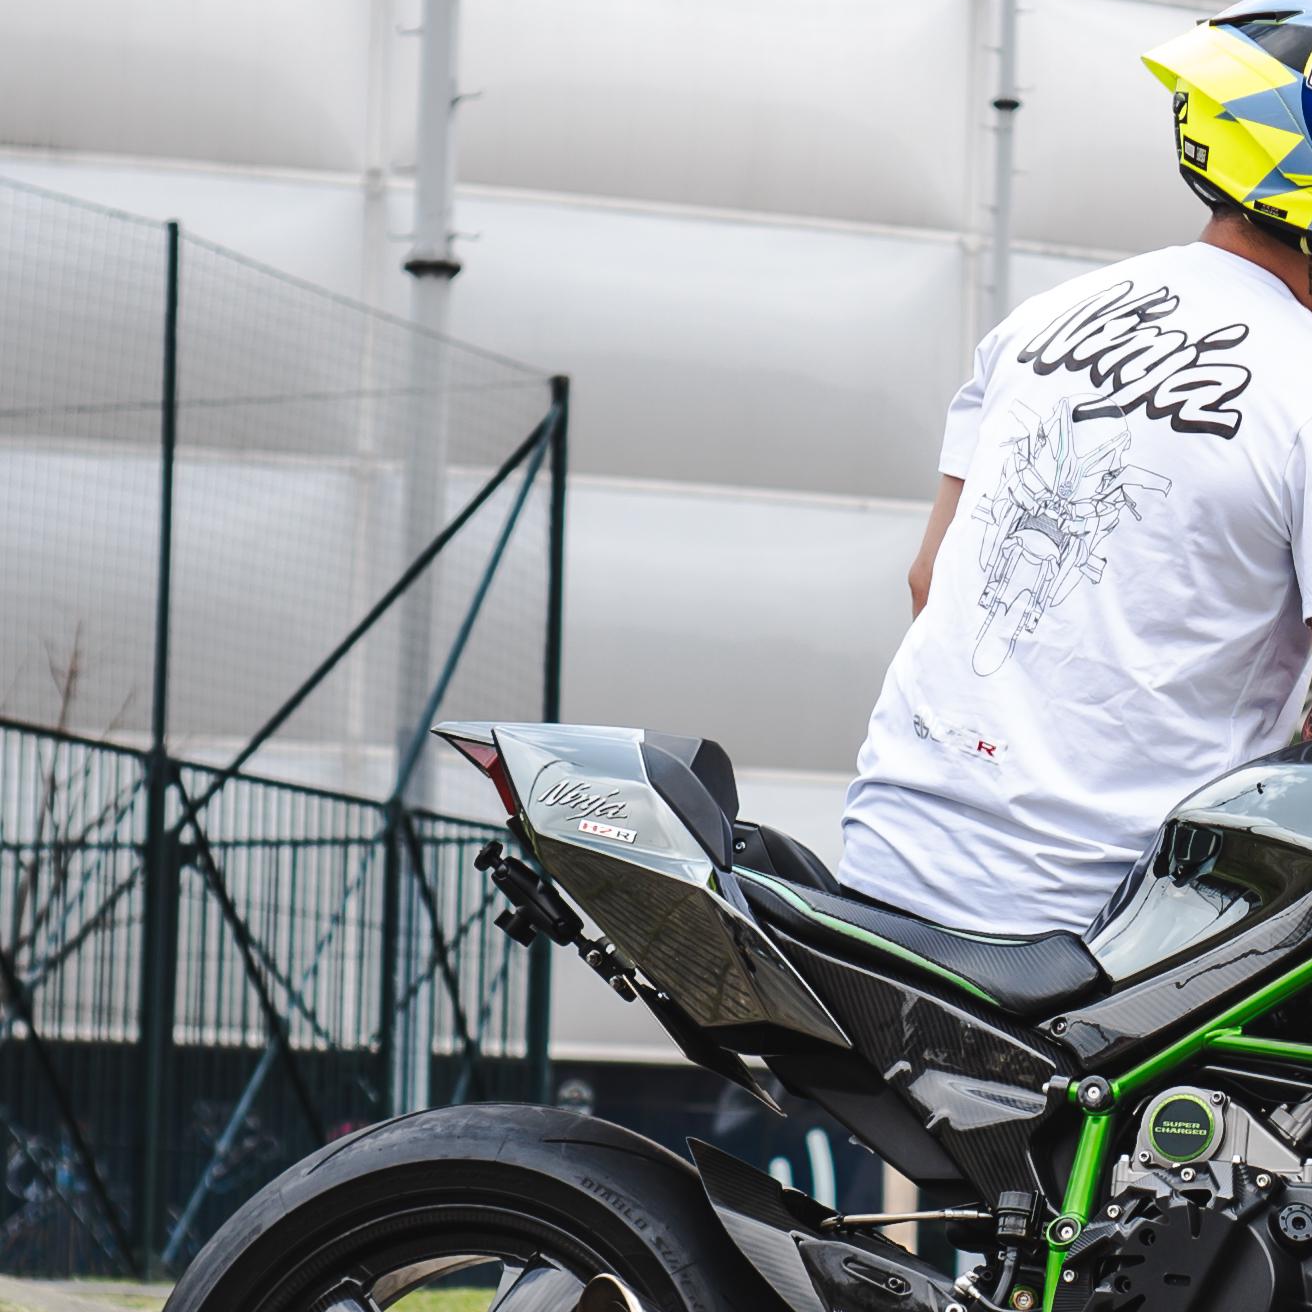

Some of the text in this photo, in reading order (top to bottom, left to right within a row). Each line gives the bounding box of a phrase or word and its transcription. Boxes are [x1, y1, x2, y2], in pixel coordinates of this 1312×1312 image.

[1017, 280, 1252, 440] Ninja
[537, 778, 628, 822] Ninja
[1154, 1126, 1207, 1136] CHARGED
[1162, 1120, 1201, 1128] SUPER
[580, 1176, 647, 1231] DIABLO
